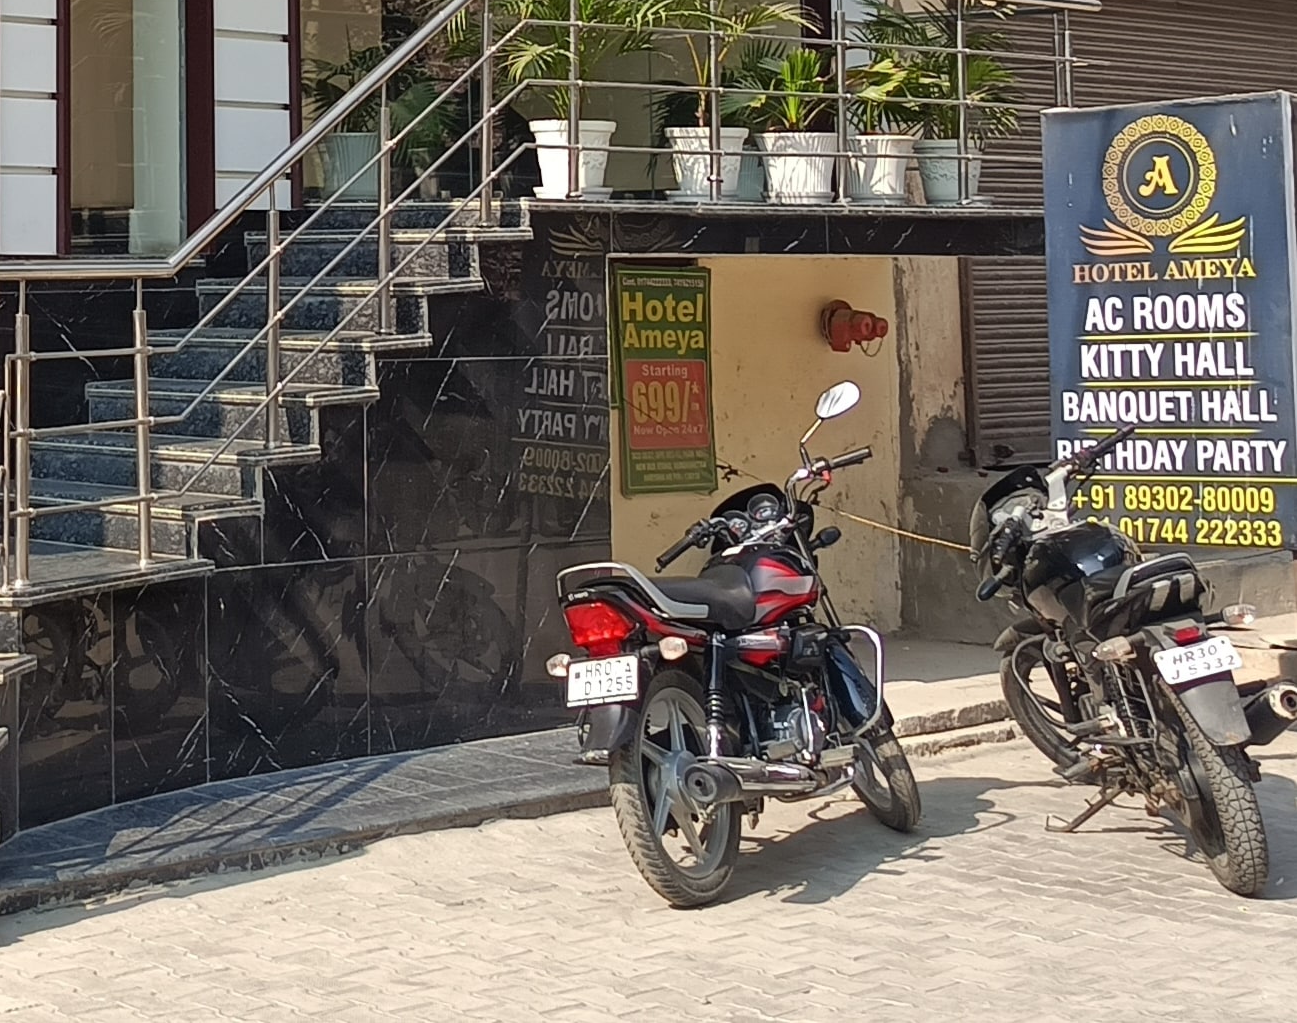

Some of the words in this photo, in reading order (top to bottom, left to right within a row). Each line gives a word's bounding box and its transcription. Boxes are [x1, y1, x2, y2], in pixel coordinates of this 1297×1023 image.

[1073, 262, 1158, 284] HOTEL
[1162, 257, 1256, 281] AMEYA
[622, 291, 704, 323] Hotel
[1084, 296, 1124, 332] AC
[1133, 292, 1247, 330] ROOMS
[623, 323, 705, 355] Ameya
[641, 364, 688, 379] Starting
[1080, 342, 1164, 380] KITTY
[1174, 340, 1254, 378] HALL
[1062, 390, 1194, 424] BANQUET
[1201, 389, 1277, 423] HALL
[633, 425, 654, 435] Now
[681, 424, 704, 435] 24x7
[1196, 441, 1287, 473] PARTY
[1072, 485, 1115, 510] +91
[1124, 485, 1275, 513] 89302-80009
[1119, 517, 1189, 544] 01744
[1196, 518, 1283, 547] 222333
[1172, 644, 1218, 666] HR30
